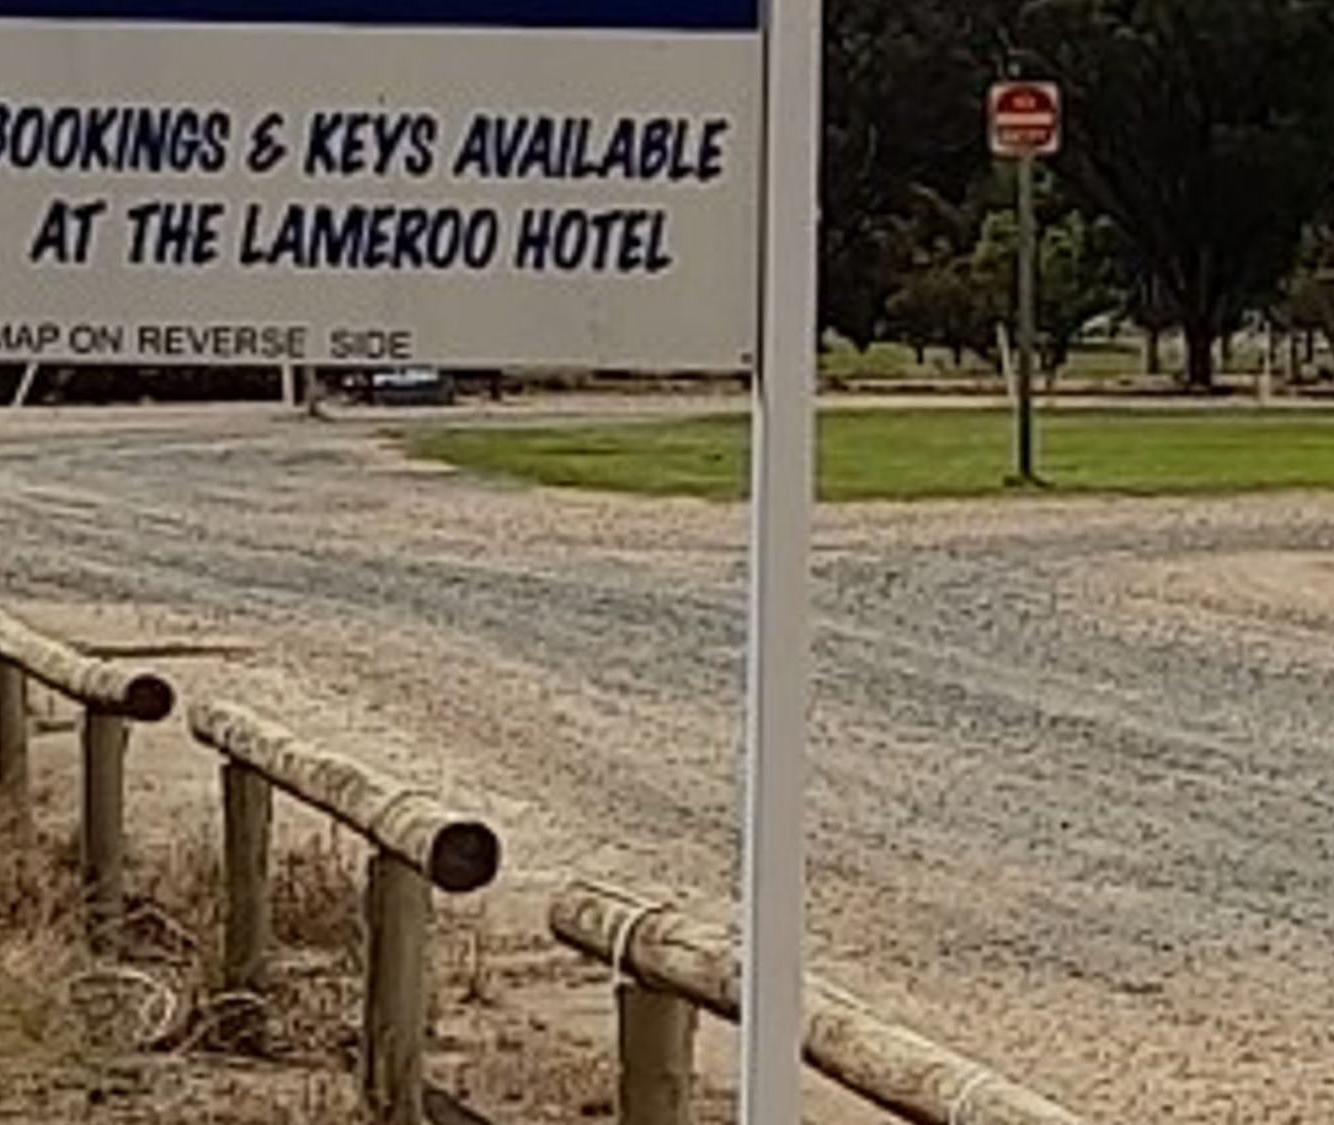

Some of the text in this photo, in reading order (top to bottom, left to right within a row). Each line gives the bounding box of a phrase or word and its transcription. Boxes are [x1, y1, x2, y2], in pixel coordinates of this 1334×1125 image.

[247, 112, 287, 173] &
[304, 112, 437, 176] KEYS
[452, 113, 729, 182] AVAILABLE
[29, 199, 673, 272] AT THE LAMEROO HOTEL
[69, 324, 124, 353] ON
[138, 325, 307, 358] REVERSE
[330, 329, 413, 359] SIDE
